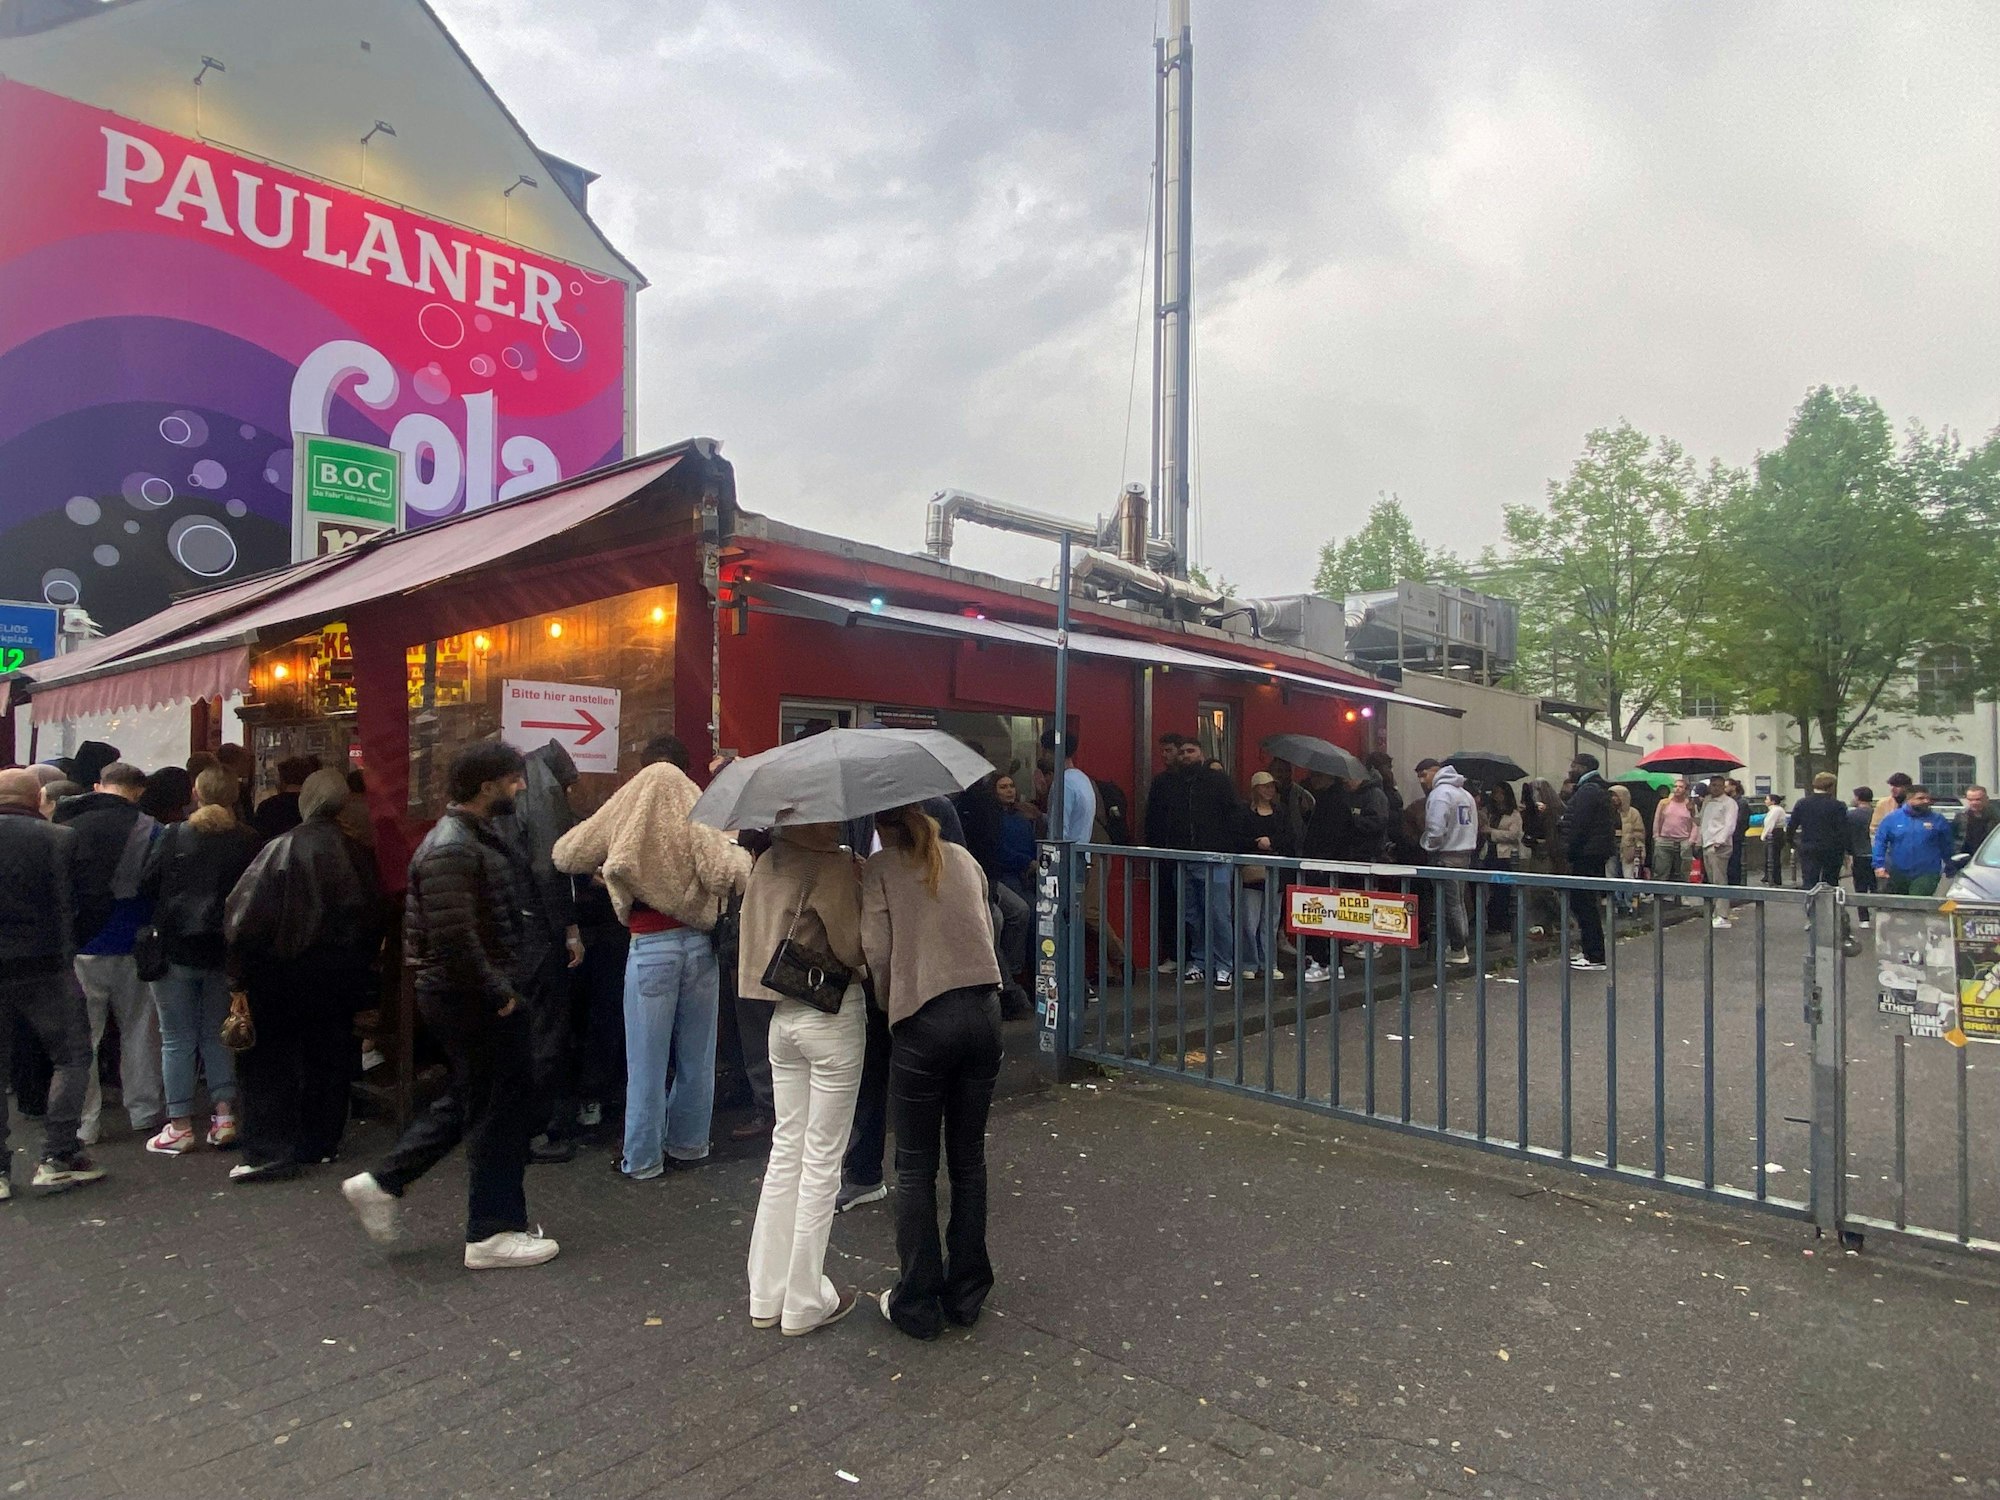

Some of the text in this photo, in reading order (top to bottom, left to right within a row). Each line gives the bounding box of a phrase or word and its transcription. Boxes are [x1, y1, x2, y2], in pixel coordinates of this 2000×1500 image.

[98, 126, 567, 332] PAULANER
[290, 339, 559, 512] Cola
[320, 463, 387, 493] B.O.C.
[511, 688, 614, 706] Bitte hier anstellen
[1339, 897, 1370, 908] ACAB
[1337, 909, 1371, 922] ULTRAS
